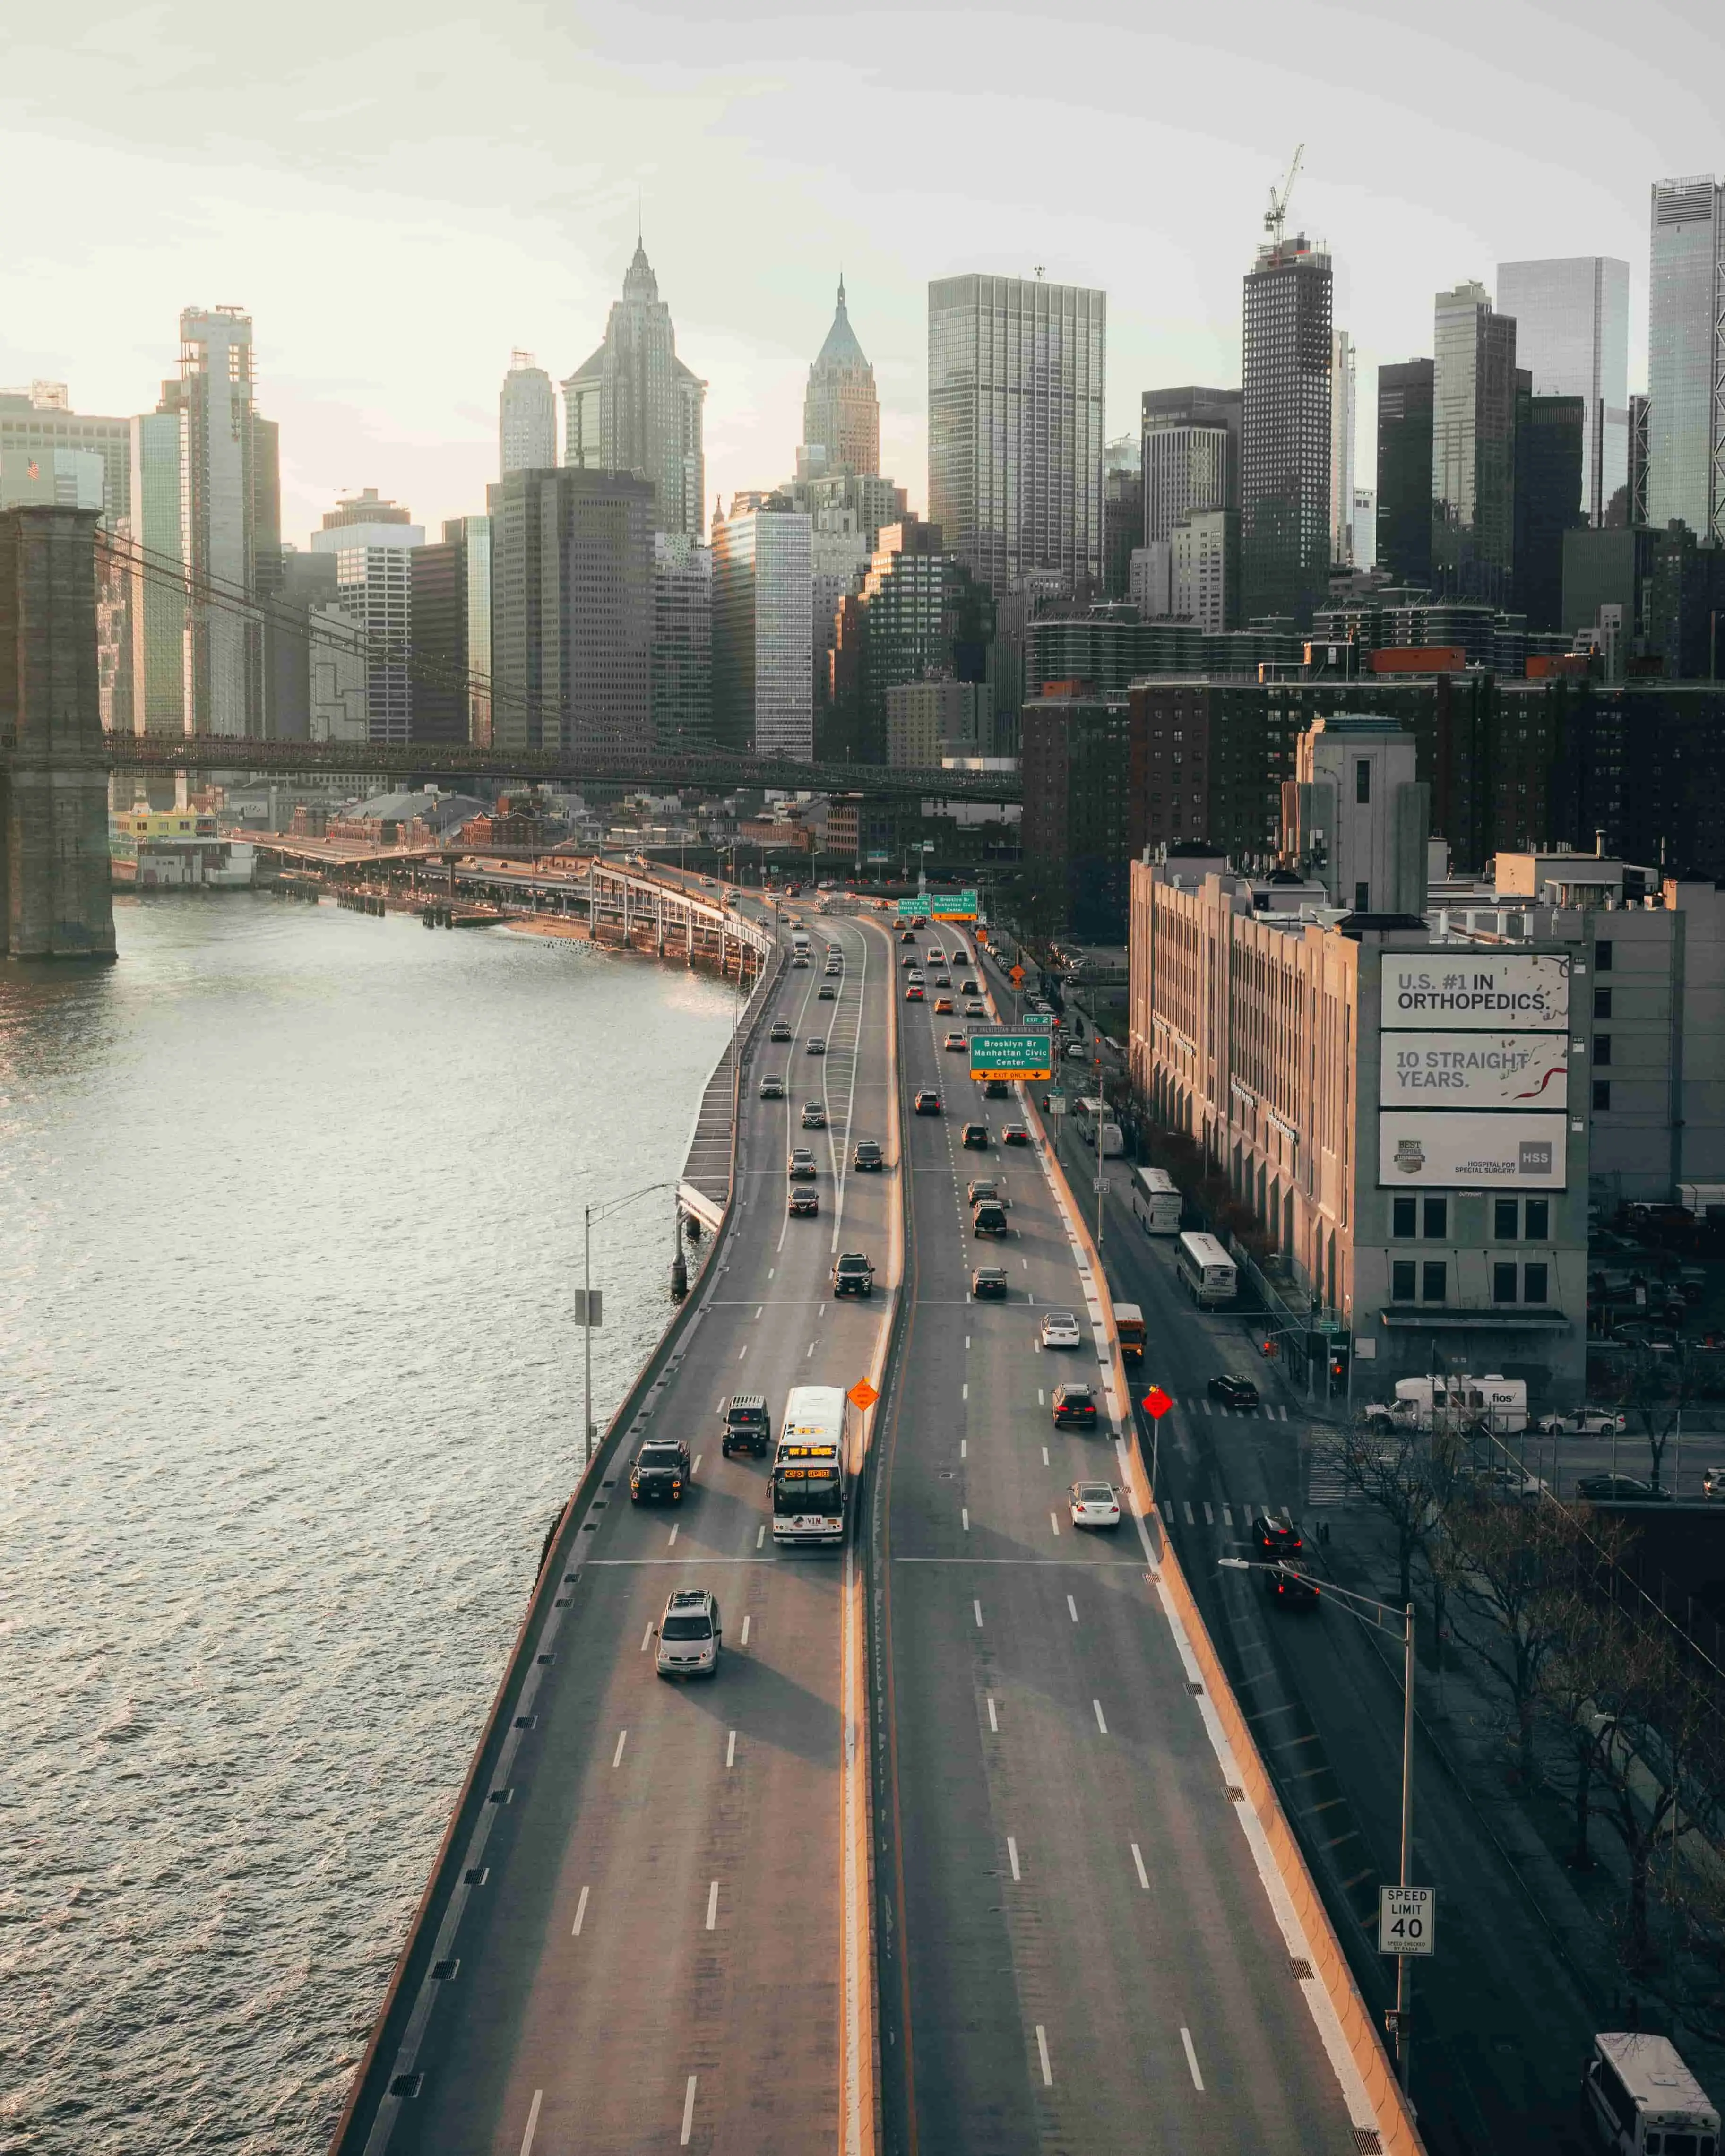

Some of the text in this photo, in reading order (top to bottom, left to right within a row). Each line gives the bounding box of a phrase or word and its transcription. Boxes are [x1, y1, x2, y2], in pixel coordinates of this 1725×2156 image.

[1398, 974, 1493, 990] U.S. #1 IN
[1398, 993, 1550, 1010] ORTHOPEDICS.
[1397, 1052, 1529, 1069] 10 STRAIGHT
[1398, 1072, 1469, 1088] YEARS.
[1523, 1153, 1548, 1163] HSS
[1492, 1393, 1512, 1402] fios
[1388, 1890, 1427, 1901] SPEED
[1391, 1904, 1422, 1915] LIMIT
[1391, 1918, 1422, 1938] 40
